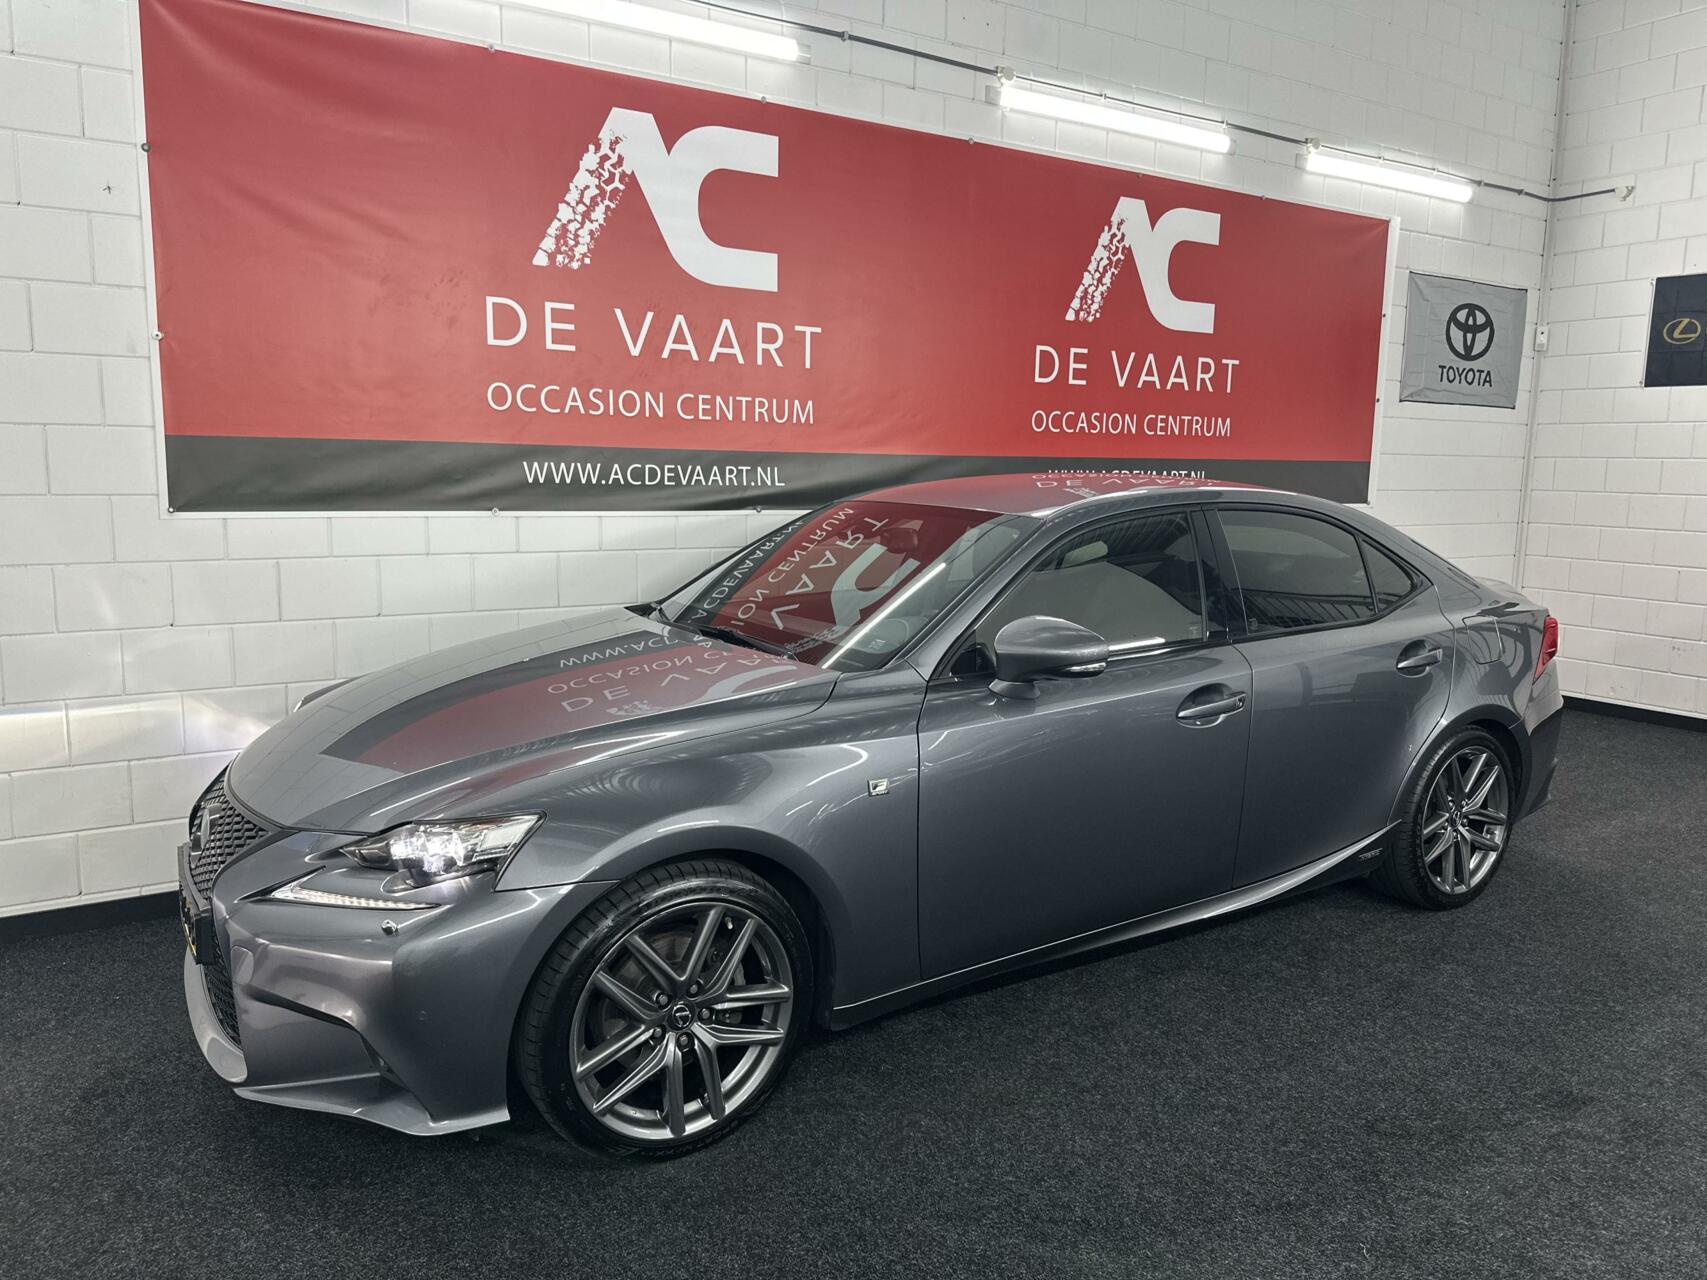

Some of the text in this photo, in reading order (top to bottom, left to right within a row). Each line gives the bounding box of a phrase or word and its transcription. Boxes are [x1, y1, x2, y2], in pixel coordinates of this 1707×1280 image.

[485, 295, 822, 369] DE VAART
[1034, 344, 1240, 393] DE VAART
[1438, 364, 1493, 388] TOYOTA
[487, 382, 814, 424] OCCASION CENTRUM
[1031, 410, 1231, 437] OCCASION CENTRUM
[522, 461, 786, 487] WWW.ACDEVAART.NL
